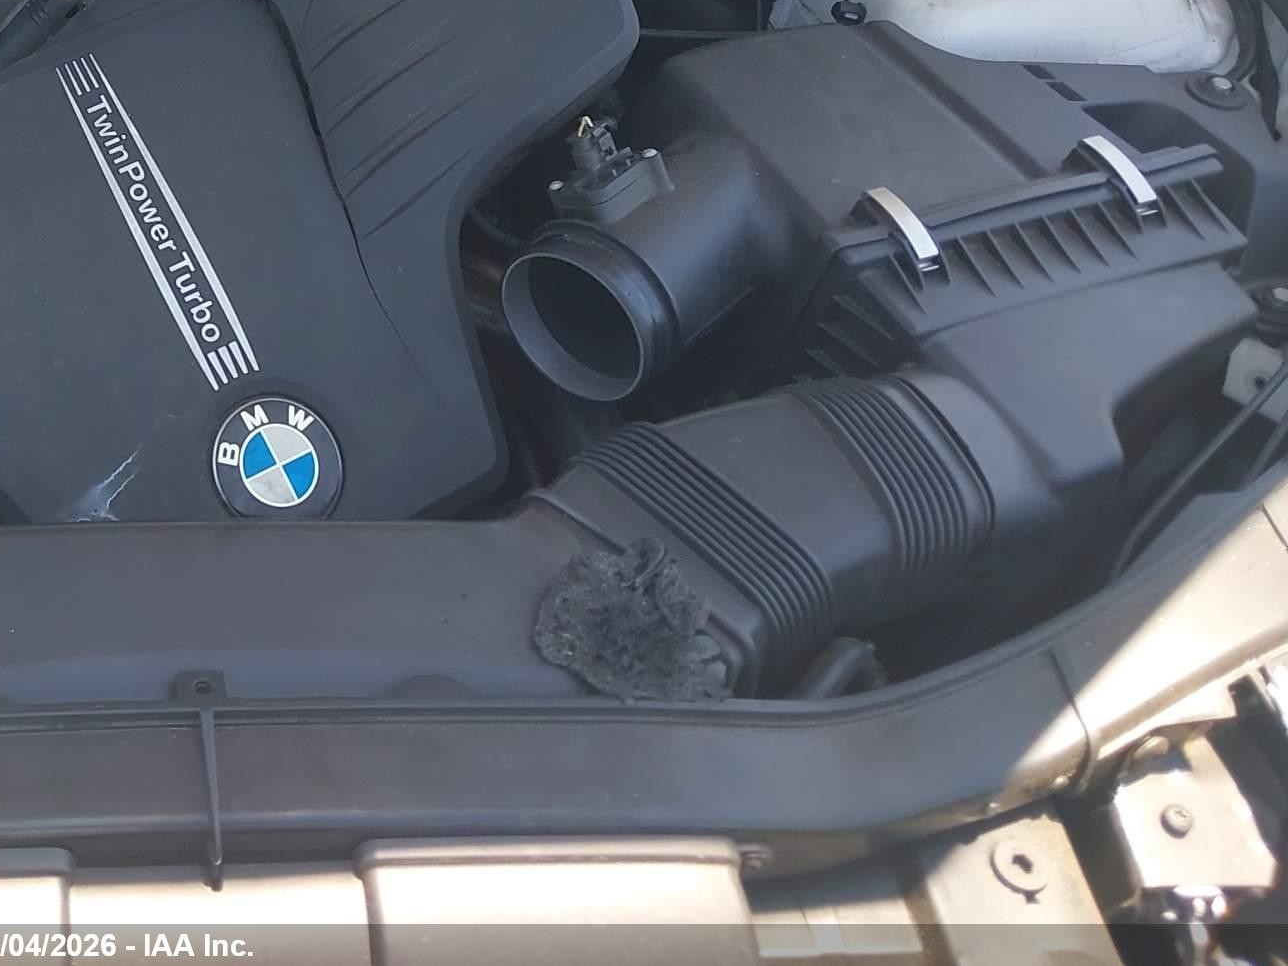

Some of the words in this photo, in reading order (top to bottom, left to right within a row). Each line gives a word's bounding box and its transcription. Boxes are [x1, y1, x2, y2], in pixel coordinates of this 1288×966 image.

[86, 94, 178, 252] TwinPower
[168, 251, 221, 343] Turbo
[217, 404, 315, 467] BMW
